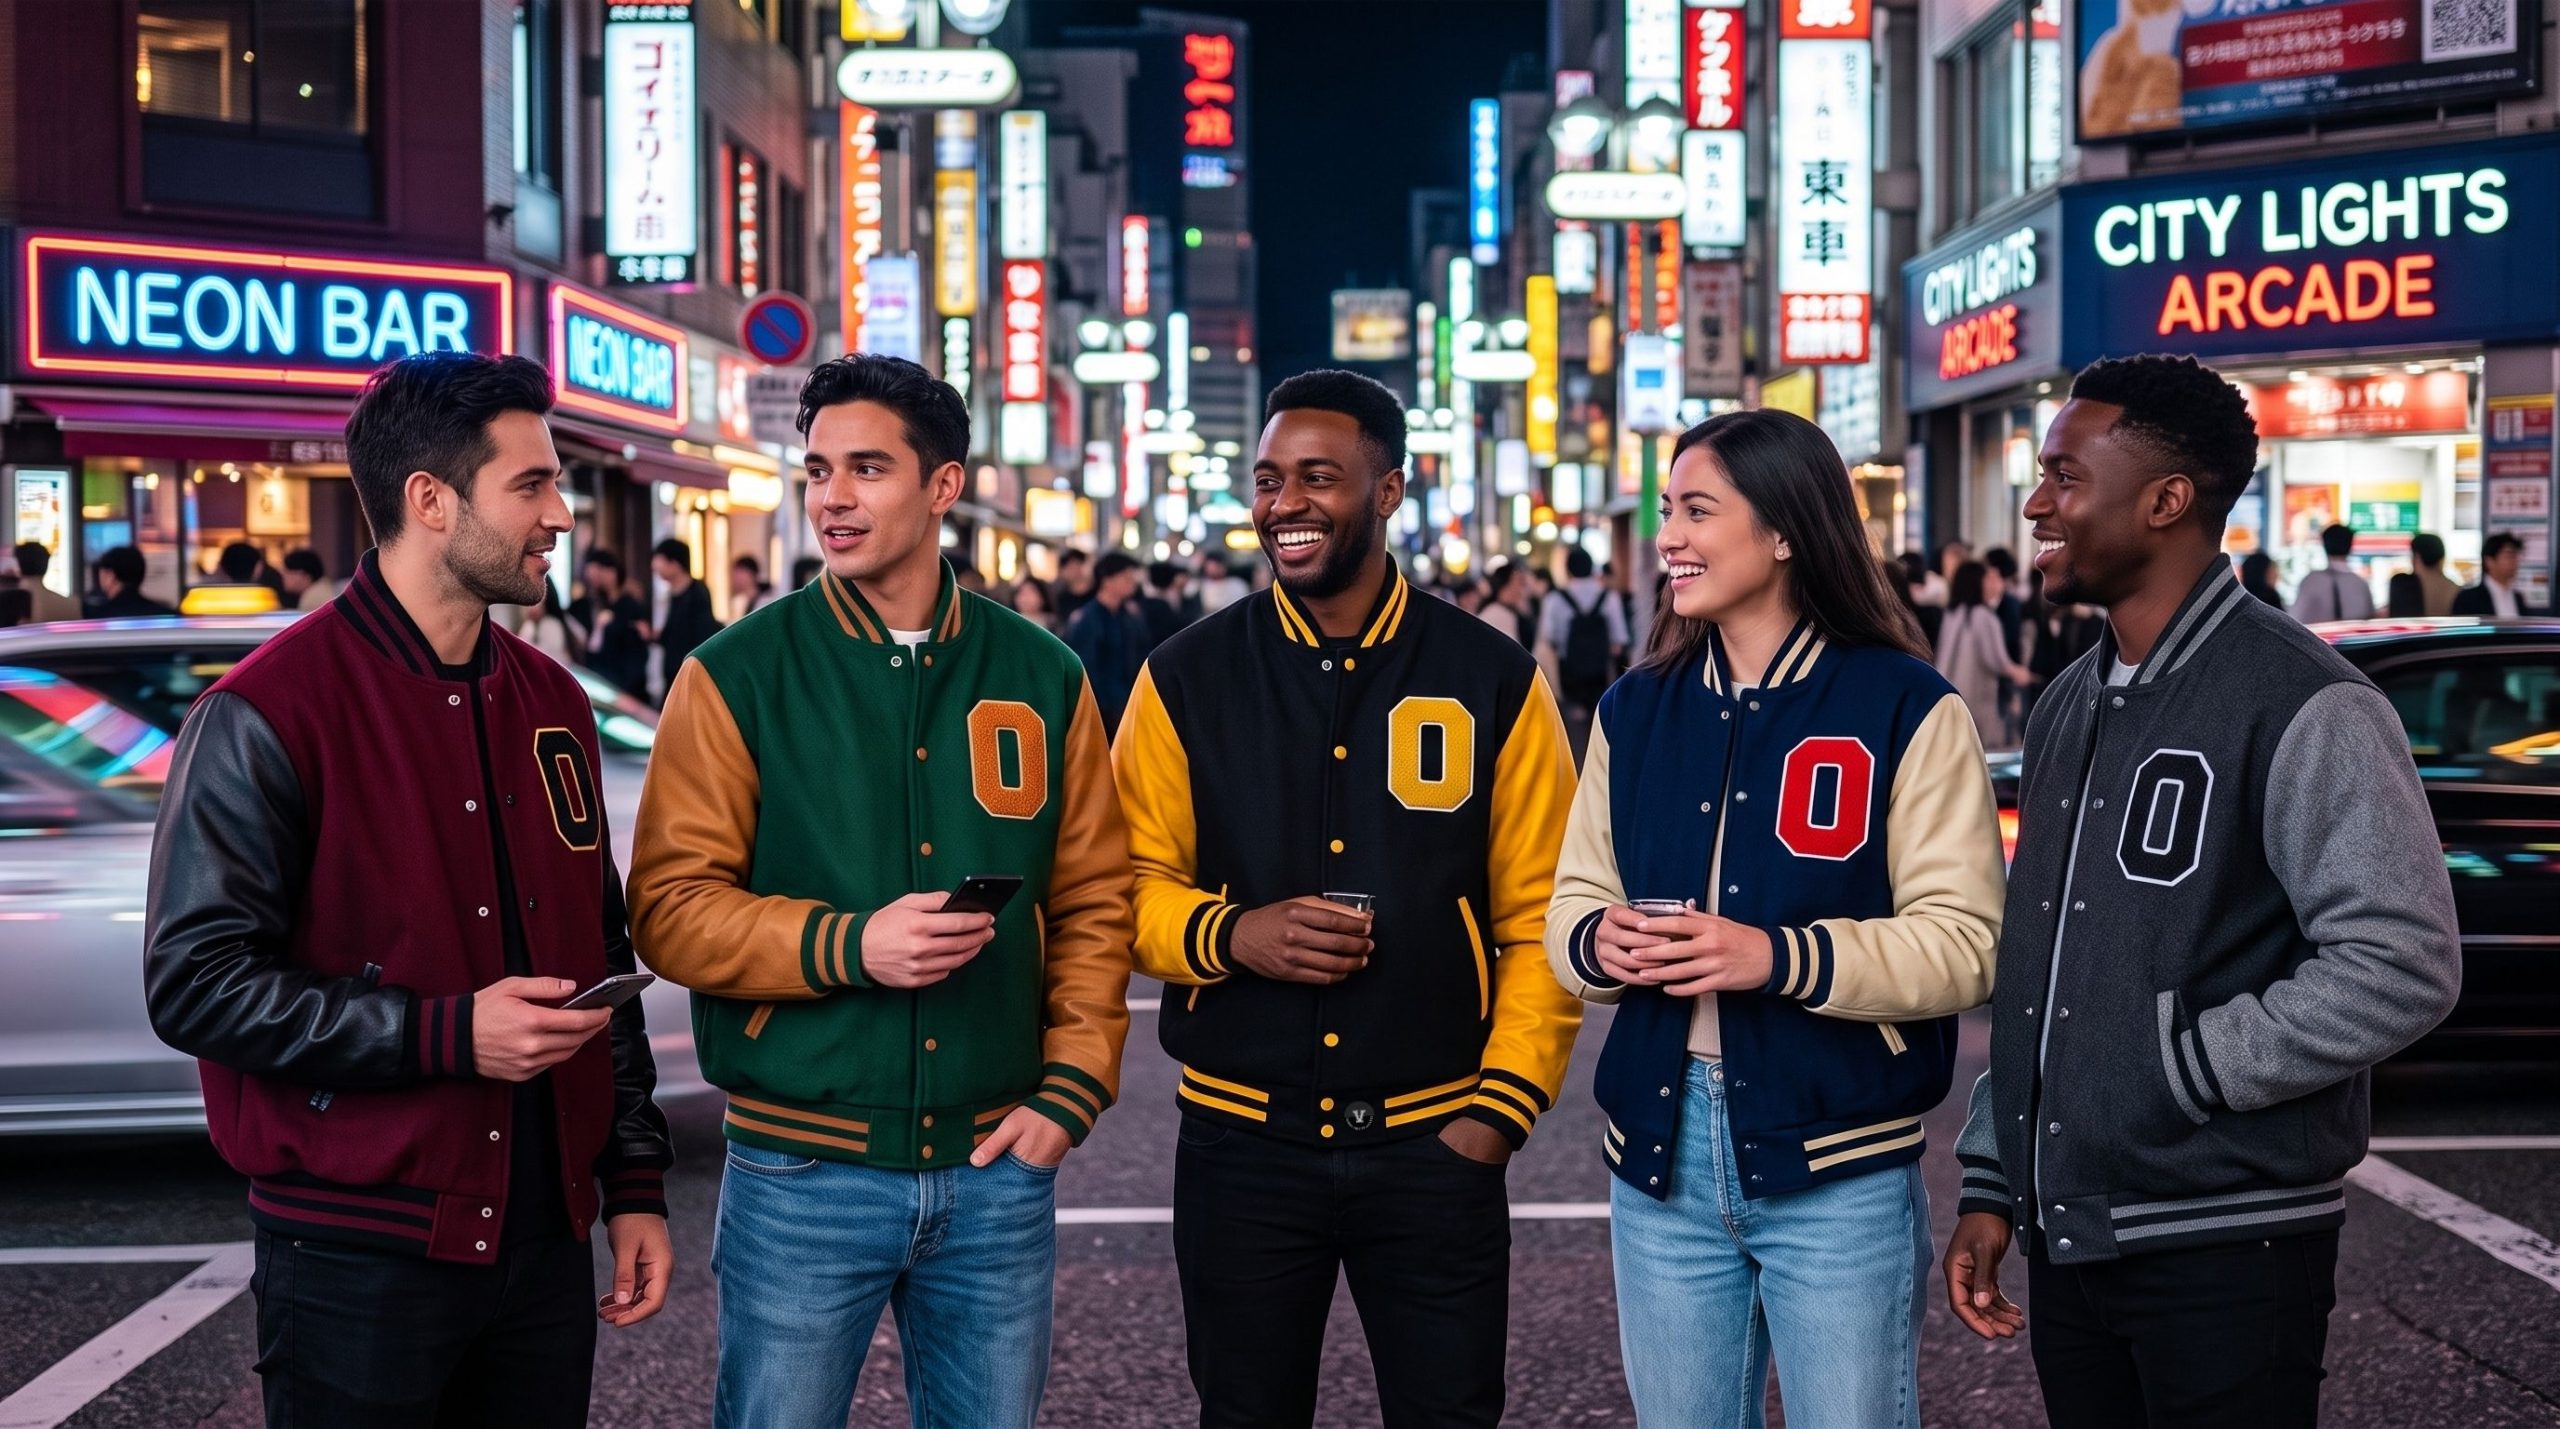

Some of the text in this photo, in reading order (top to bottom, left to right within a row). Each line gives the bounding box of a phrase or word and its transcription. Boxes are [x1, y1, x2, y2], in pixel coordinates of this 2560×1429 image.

[2094, 168, 2509, 266] CITY LIGHTS
[77, 266, 469, 361] NEON BAR
[1923, 227, 2036, 326] CITY LIGHTS
[2157, 254, 2435, 335] ARCADE
[569, 315, 631, 398] NEON
[631, 337, 673, 409] BAR
[1939, 303, 2018, 380] ARCADE
[1352, 1109, 1366, 1123] V
